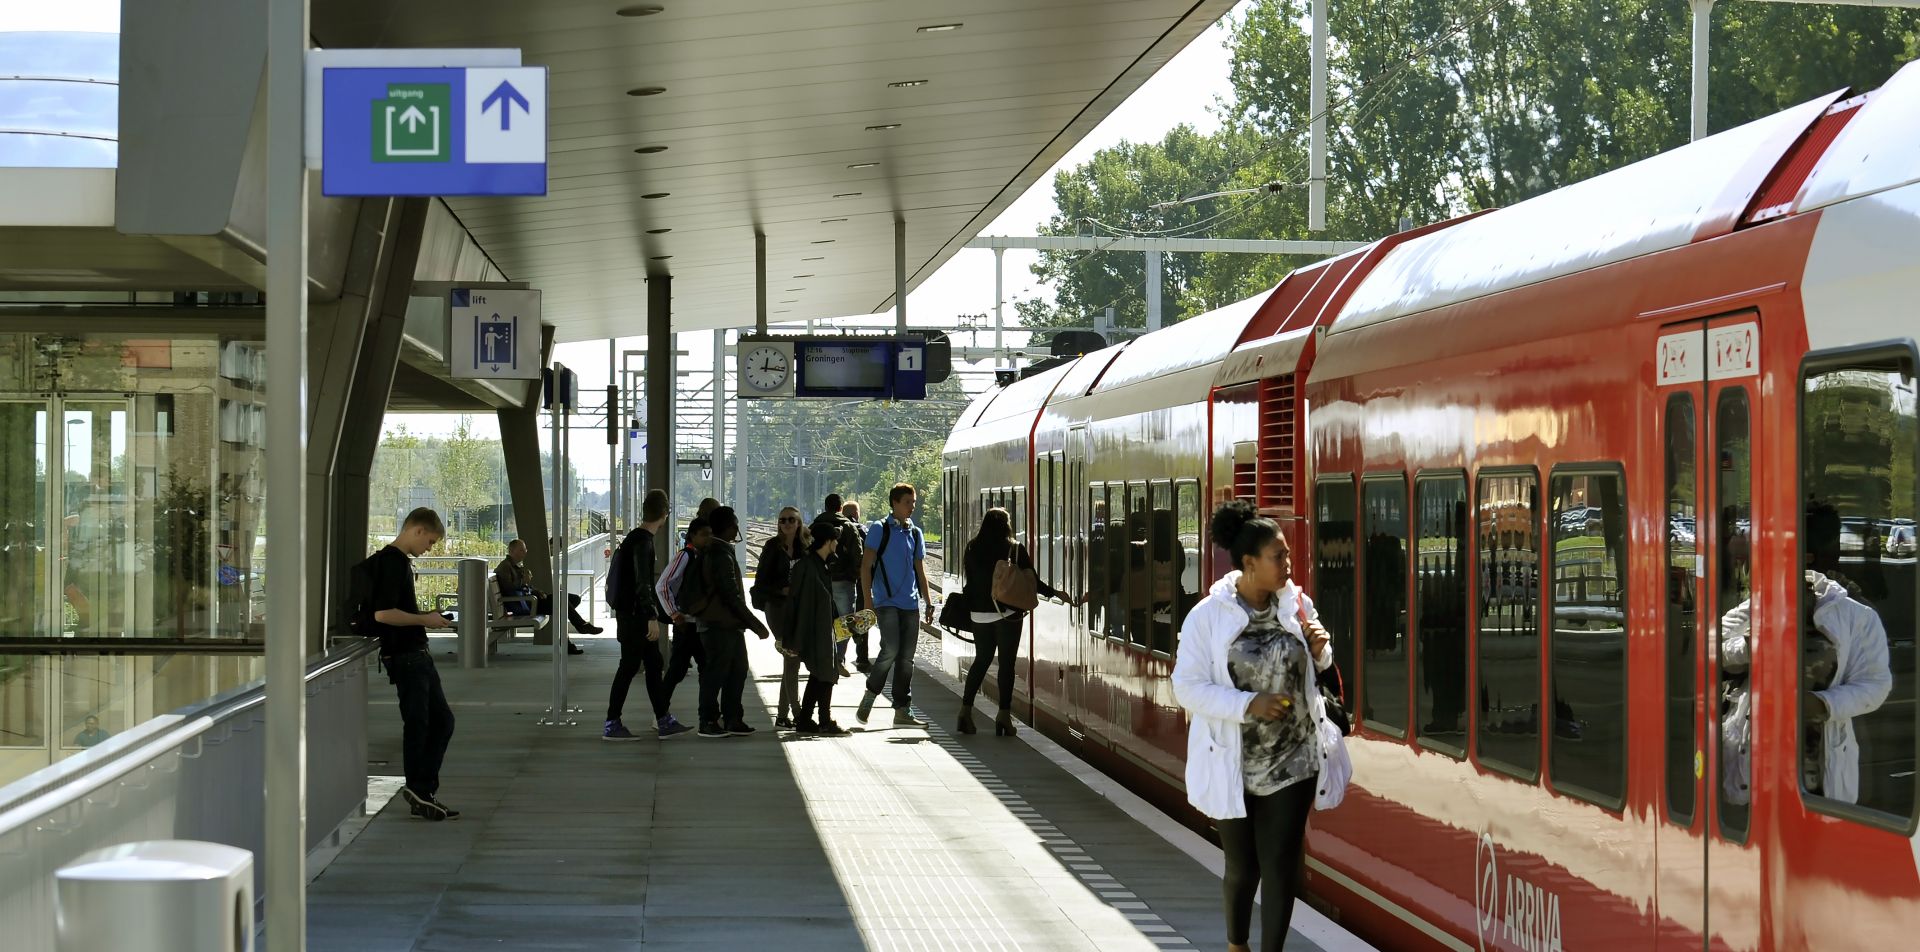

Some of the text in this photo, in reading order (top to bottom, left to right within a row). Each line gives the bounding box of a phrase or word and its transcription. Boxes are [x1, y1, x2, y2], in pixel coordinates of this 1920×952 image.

[389, 89, 424, 99] uitgang
[472, 295, 487, 304] lift
[1745, 329, 1752, 368] 2
[805, 355, 845, 364] Groningen
[907, 356, 913, 369] 1
[1662, 342, 1668, 378] 2
[703, 470, 711, 479] V
[1503, 874, 1562, 952] ARRIVA
